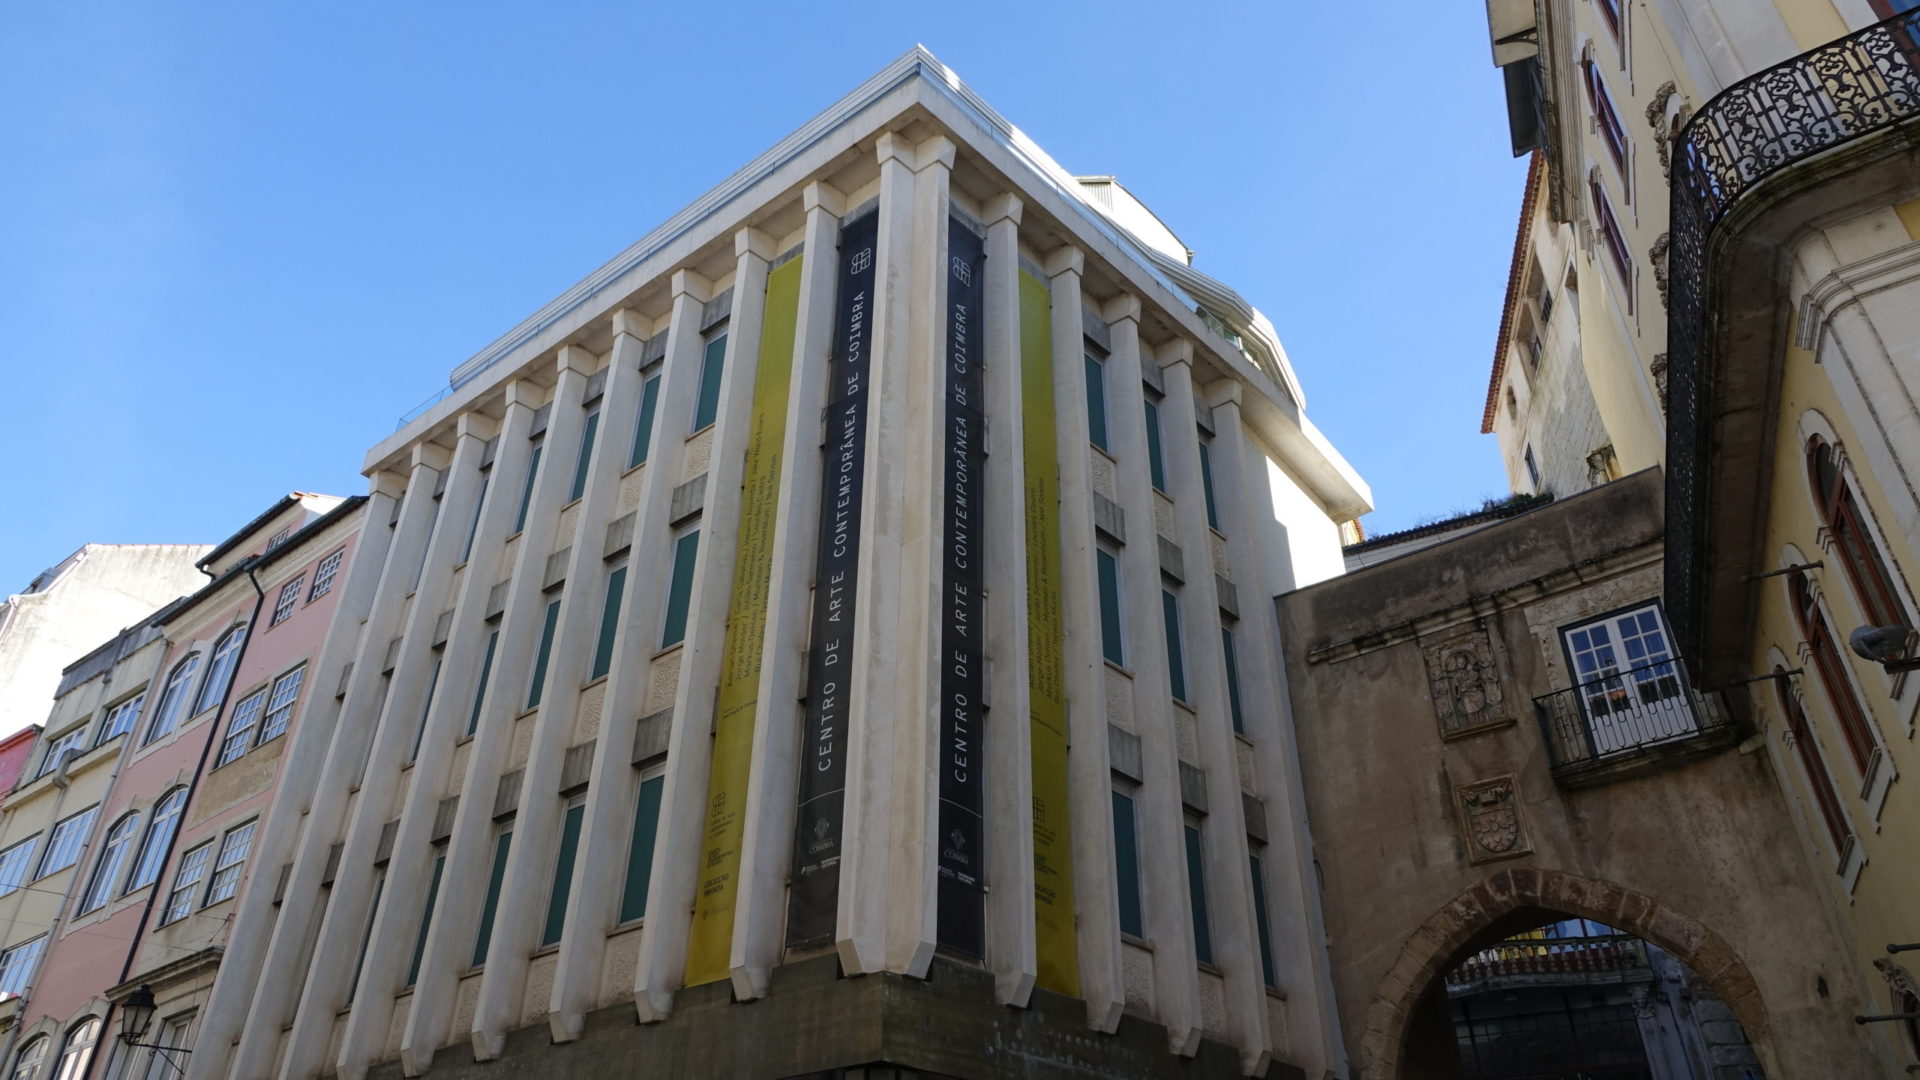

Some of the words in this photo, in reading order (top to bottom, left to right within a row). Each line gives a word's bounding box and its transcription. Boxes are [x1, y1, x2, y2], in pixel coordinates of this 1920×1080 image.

[848, 290, 865, 363] COIMBRA
[955, 303, 967, 375] COIMBRA
[847, 371, 860, 396] DE
[955, 383, 967, 407] DE
[833, 403, 858, 559] CONTEMPORÂNEA
[953, 416, 968, 570] CONTEMPORÂNEA
[828, 570, 845, 622] ARTE
[954, 581, 968, 637] ARTE
[825, 638, 840, 667] DE
[954, 649, 968, 679] DE
[818, 681, 837, 772] CENTRO
[954, 693, 968, 783] CENTRO
